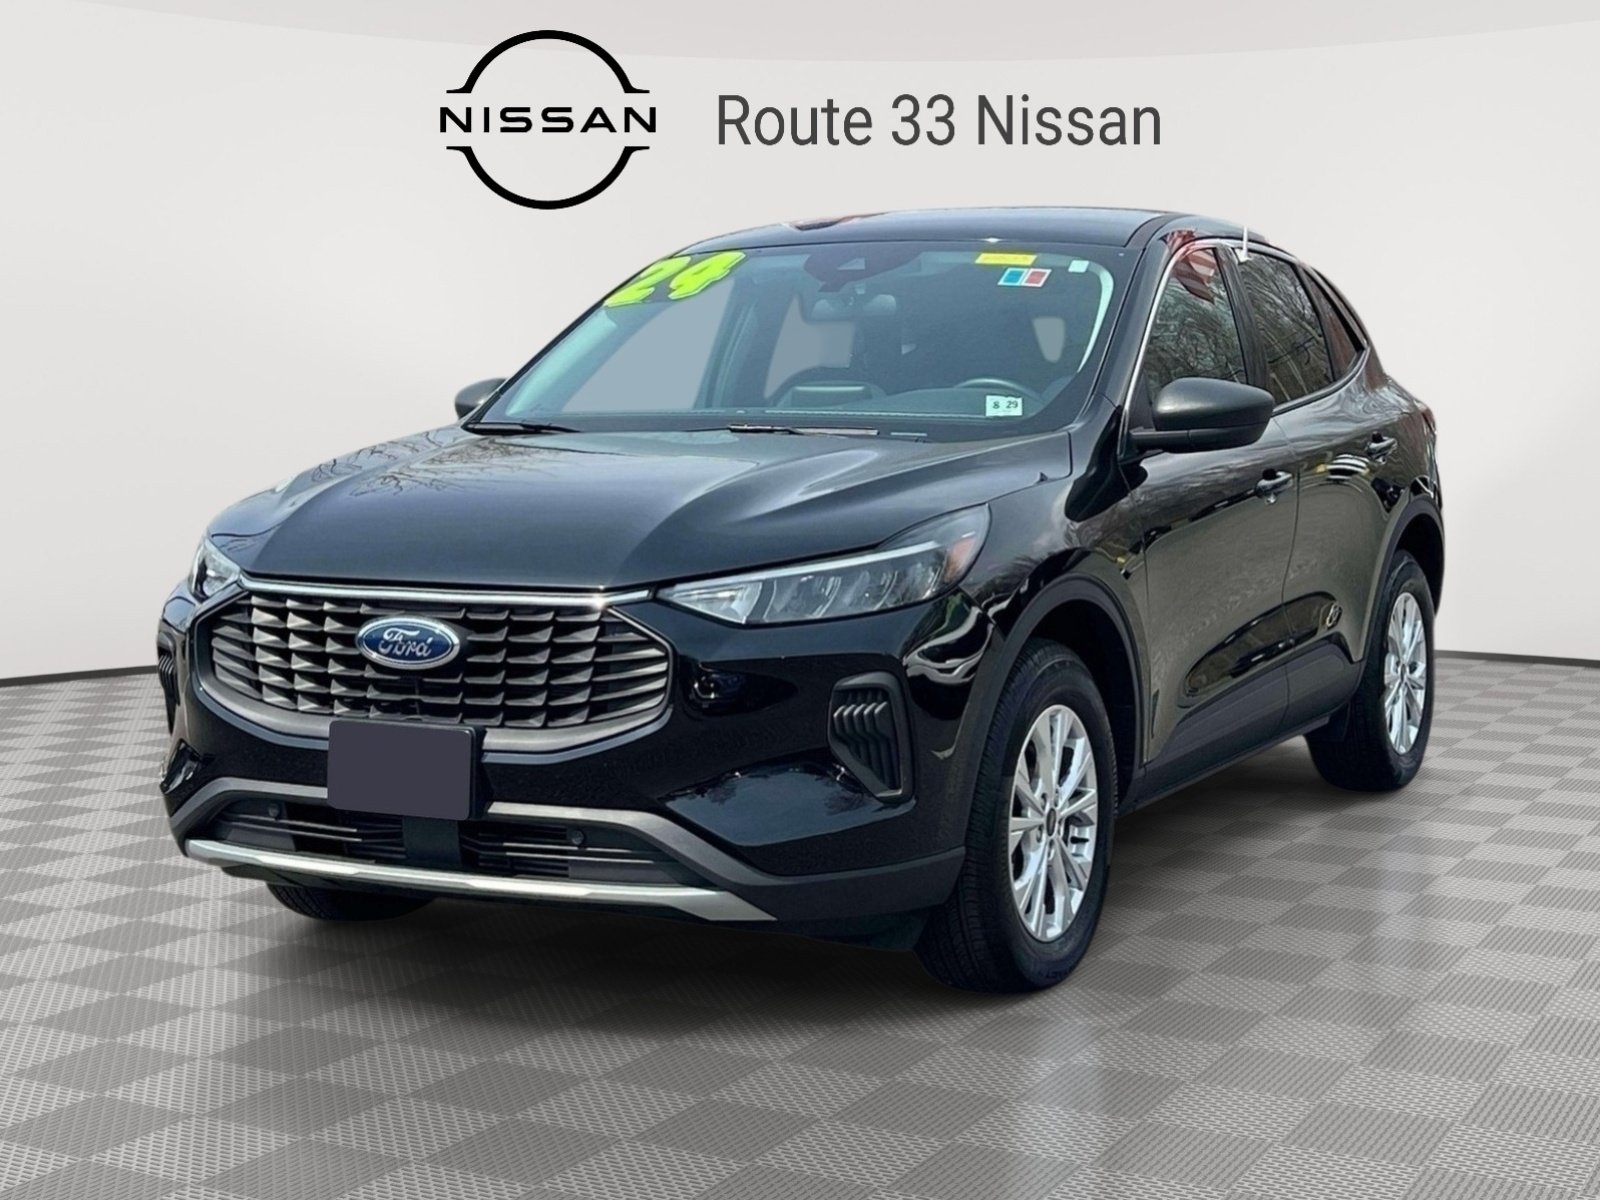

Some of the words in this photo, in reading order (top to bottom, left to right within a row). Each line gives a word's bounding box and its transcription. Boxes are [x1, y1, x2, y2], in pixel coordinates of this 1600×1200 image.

[603, 250, 746, 308] 24
[1005, 400, 1018, 409] 29
[378, 627, 433, 657] Ford
